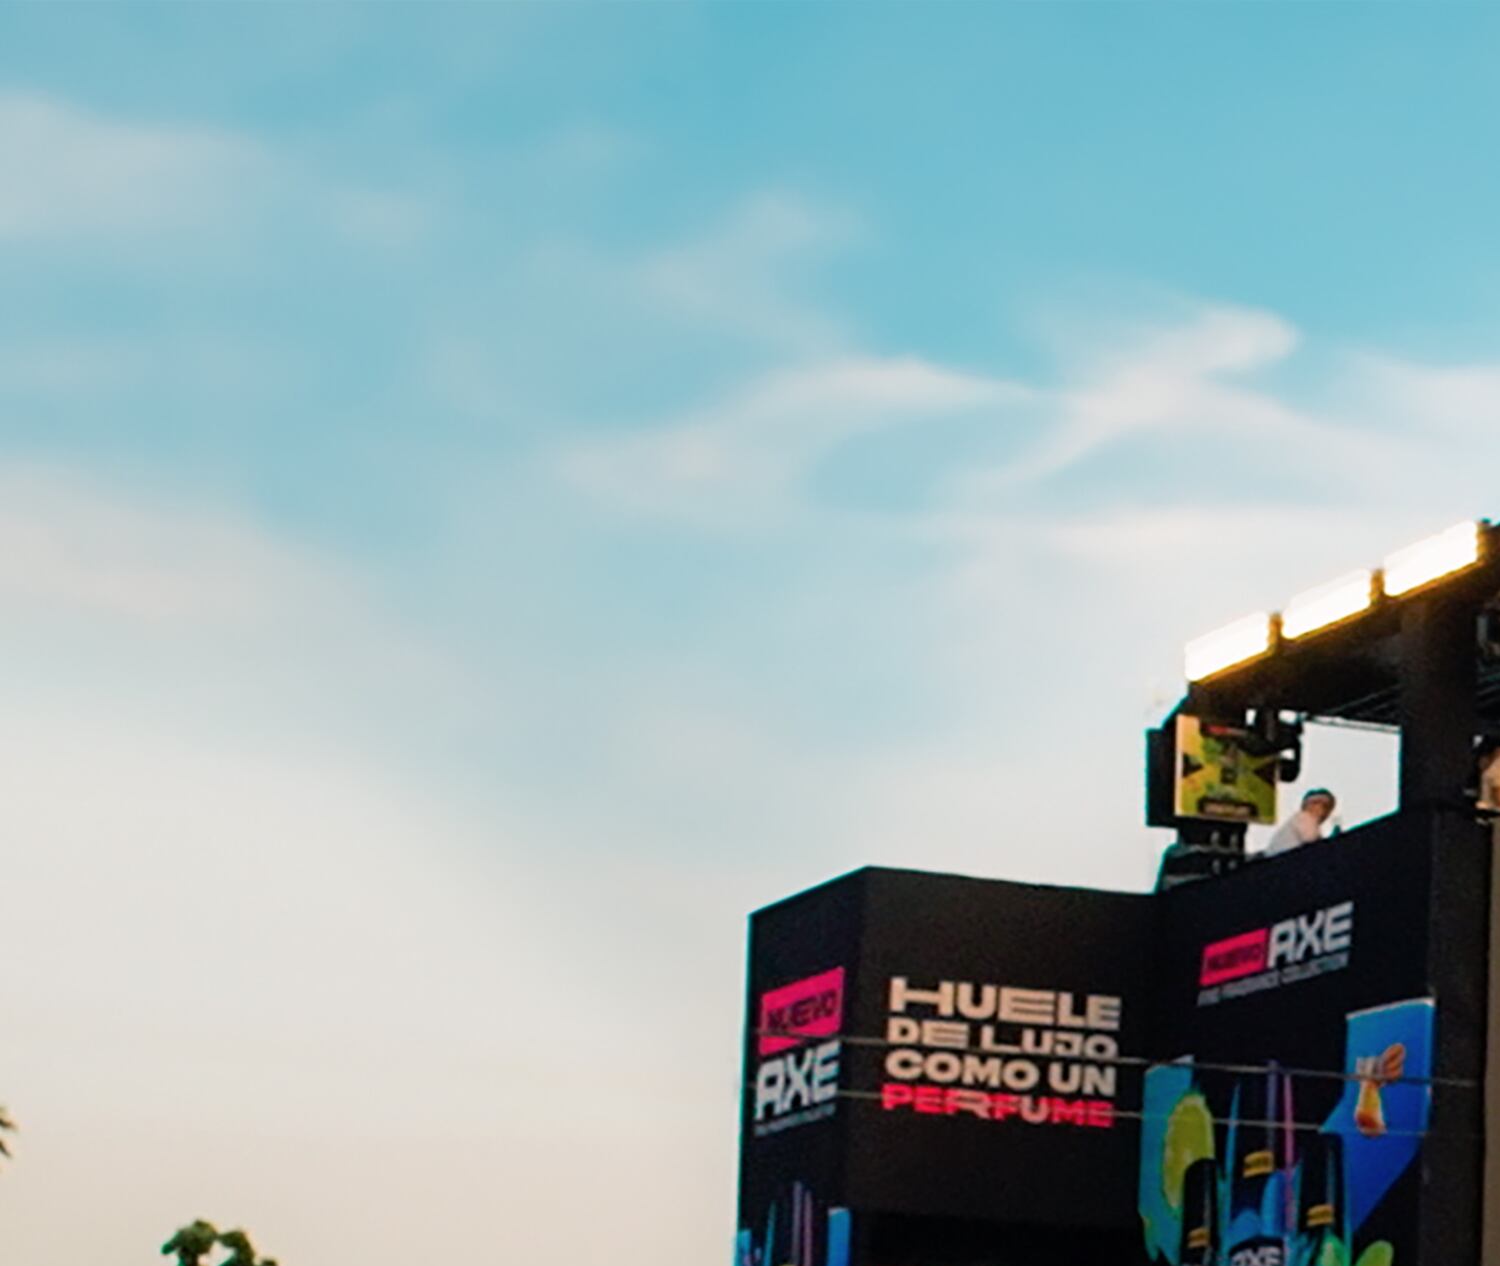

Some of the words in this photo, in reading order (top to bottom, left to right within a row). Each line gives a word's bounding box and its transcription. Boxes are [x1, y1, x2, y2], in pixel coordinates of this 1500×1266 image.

[1267, 901, 1354, 969] AXE
[889, 976, 1121, 1031] HUELE
[887, 1018, 969, 1049] DE
[981, 1025, 1118, 1059] LUJO
[755, 1040, 841, 1121] AXE
[885, 1049, 1040, 1091] COMO
[1048, 1062, 1116, 1097] UN
[881, 1083, 1114, 1128] PERFUME
